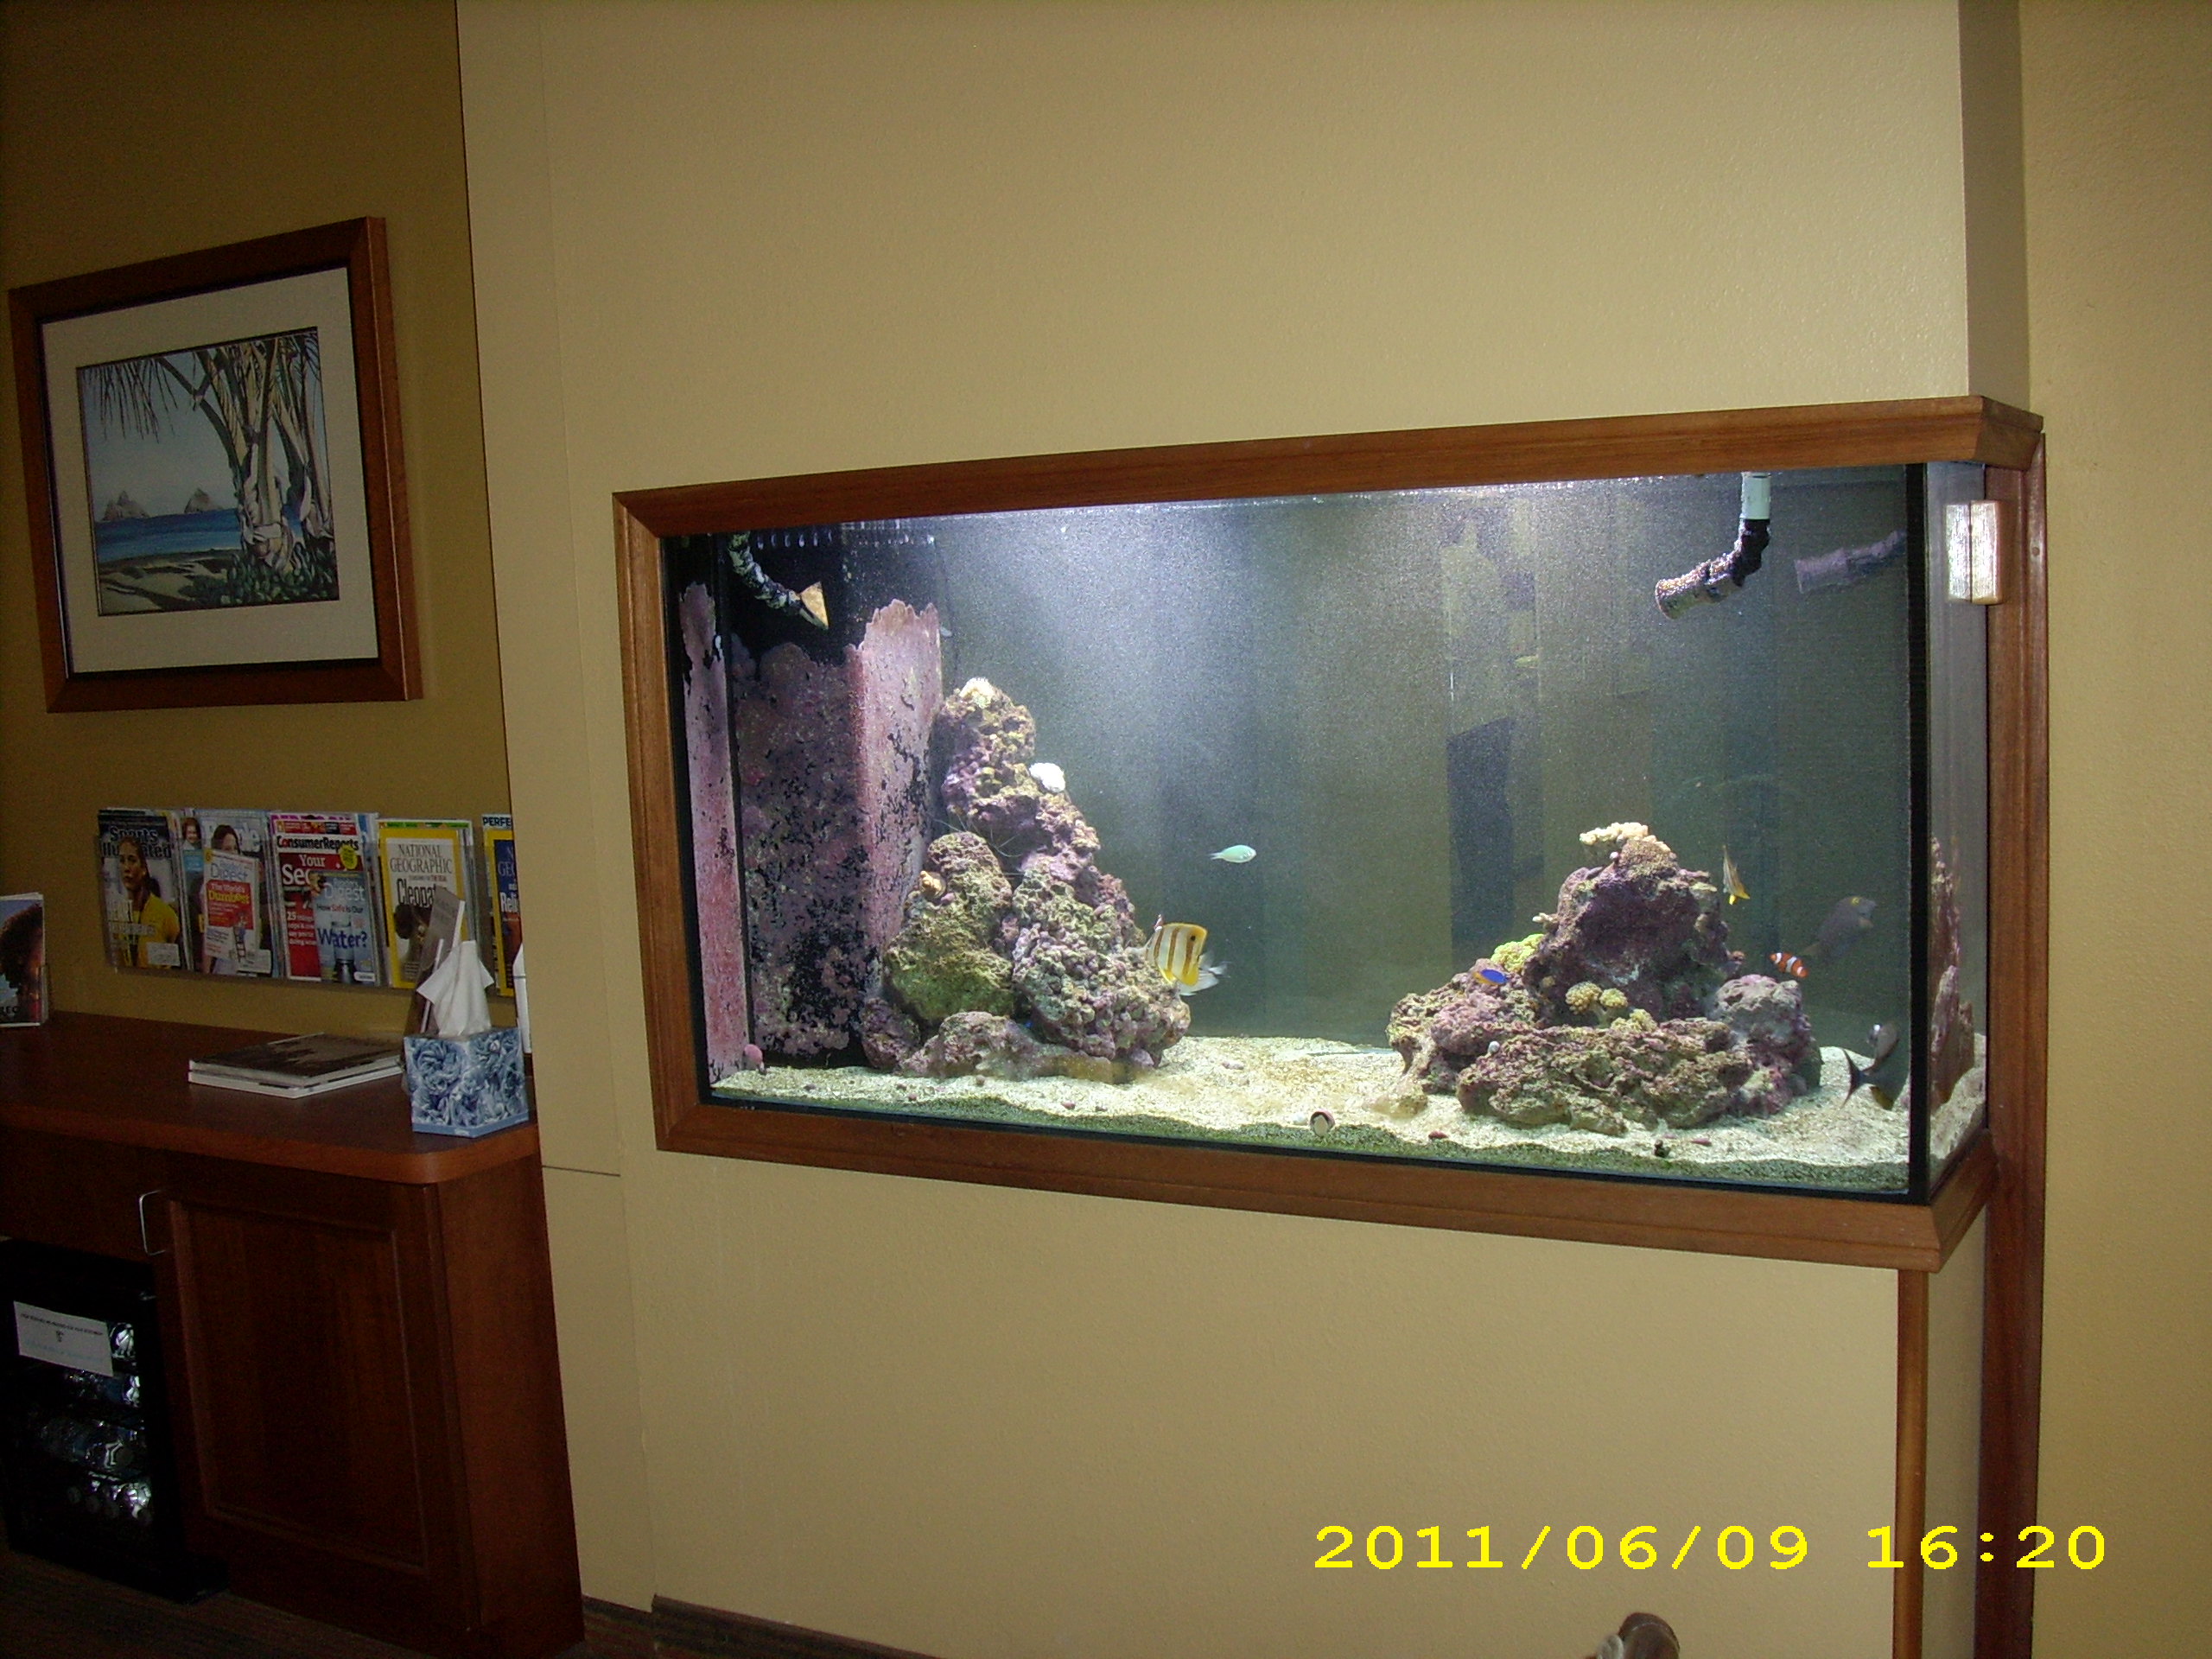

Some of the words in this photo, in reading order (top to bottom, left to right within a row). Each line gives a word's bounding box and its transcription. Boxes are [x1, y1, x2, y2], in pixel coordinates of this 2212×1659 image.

[200, 818, 262, 852] Pple
[102, 840, 173, 859] Illuated
[397, 843, 442, 858] NATIONAL
[298, 854, 326, 868] Your
[389, 857, 453, 874] GEOGRAPHIC
[317, 927, 368, 949] Water?
